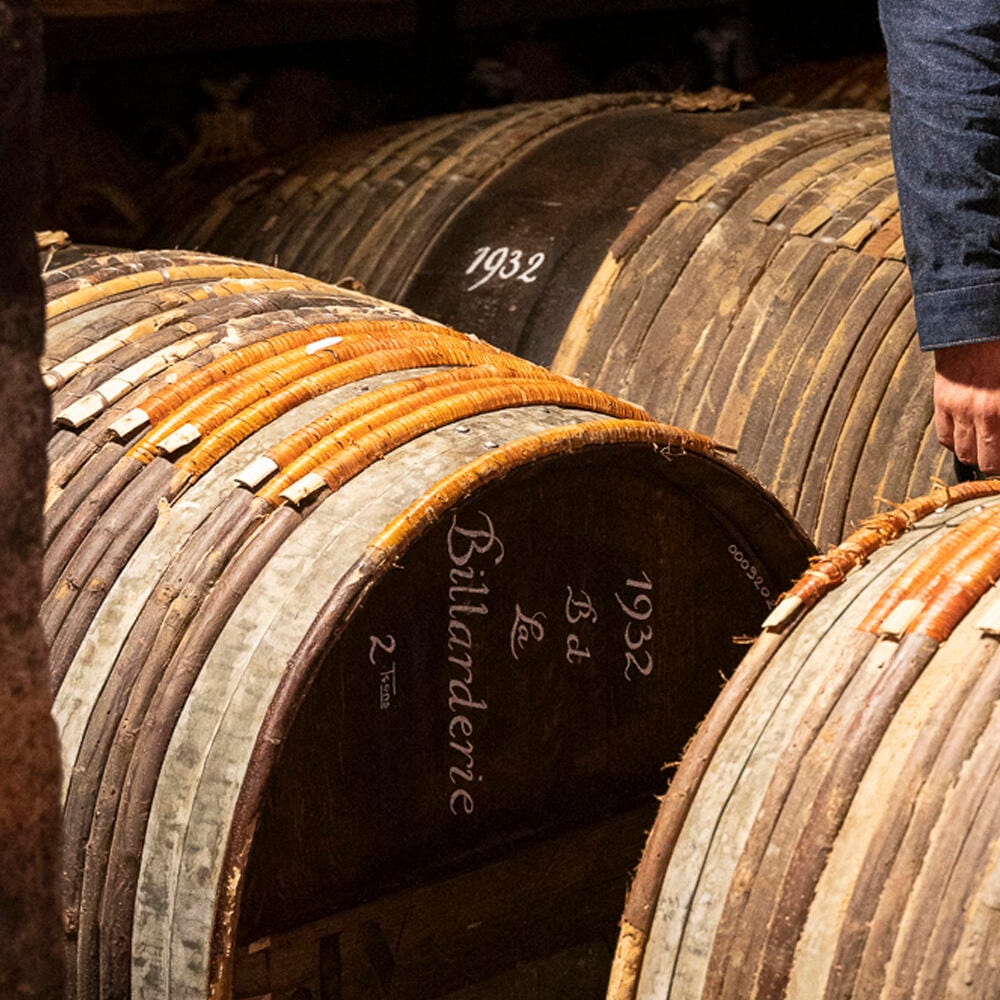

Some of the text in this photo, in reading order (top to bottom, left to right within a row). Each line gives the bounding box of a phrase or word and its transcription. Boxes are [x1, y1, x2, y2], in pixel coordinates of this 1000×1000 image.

[464, 244, 547, 291] 1932
[369, 633, 396, 665] 2
[510, 602, 549, 661] La
[614, 570, 654, 682] 1932
[446, 510, 505, 816] Billarderie
